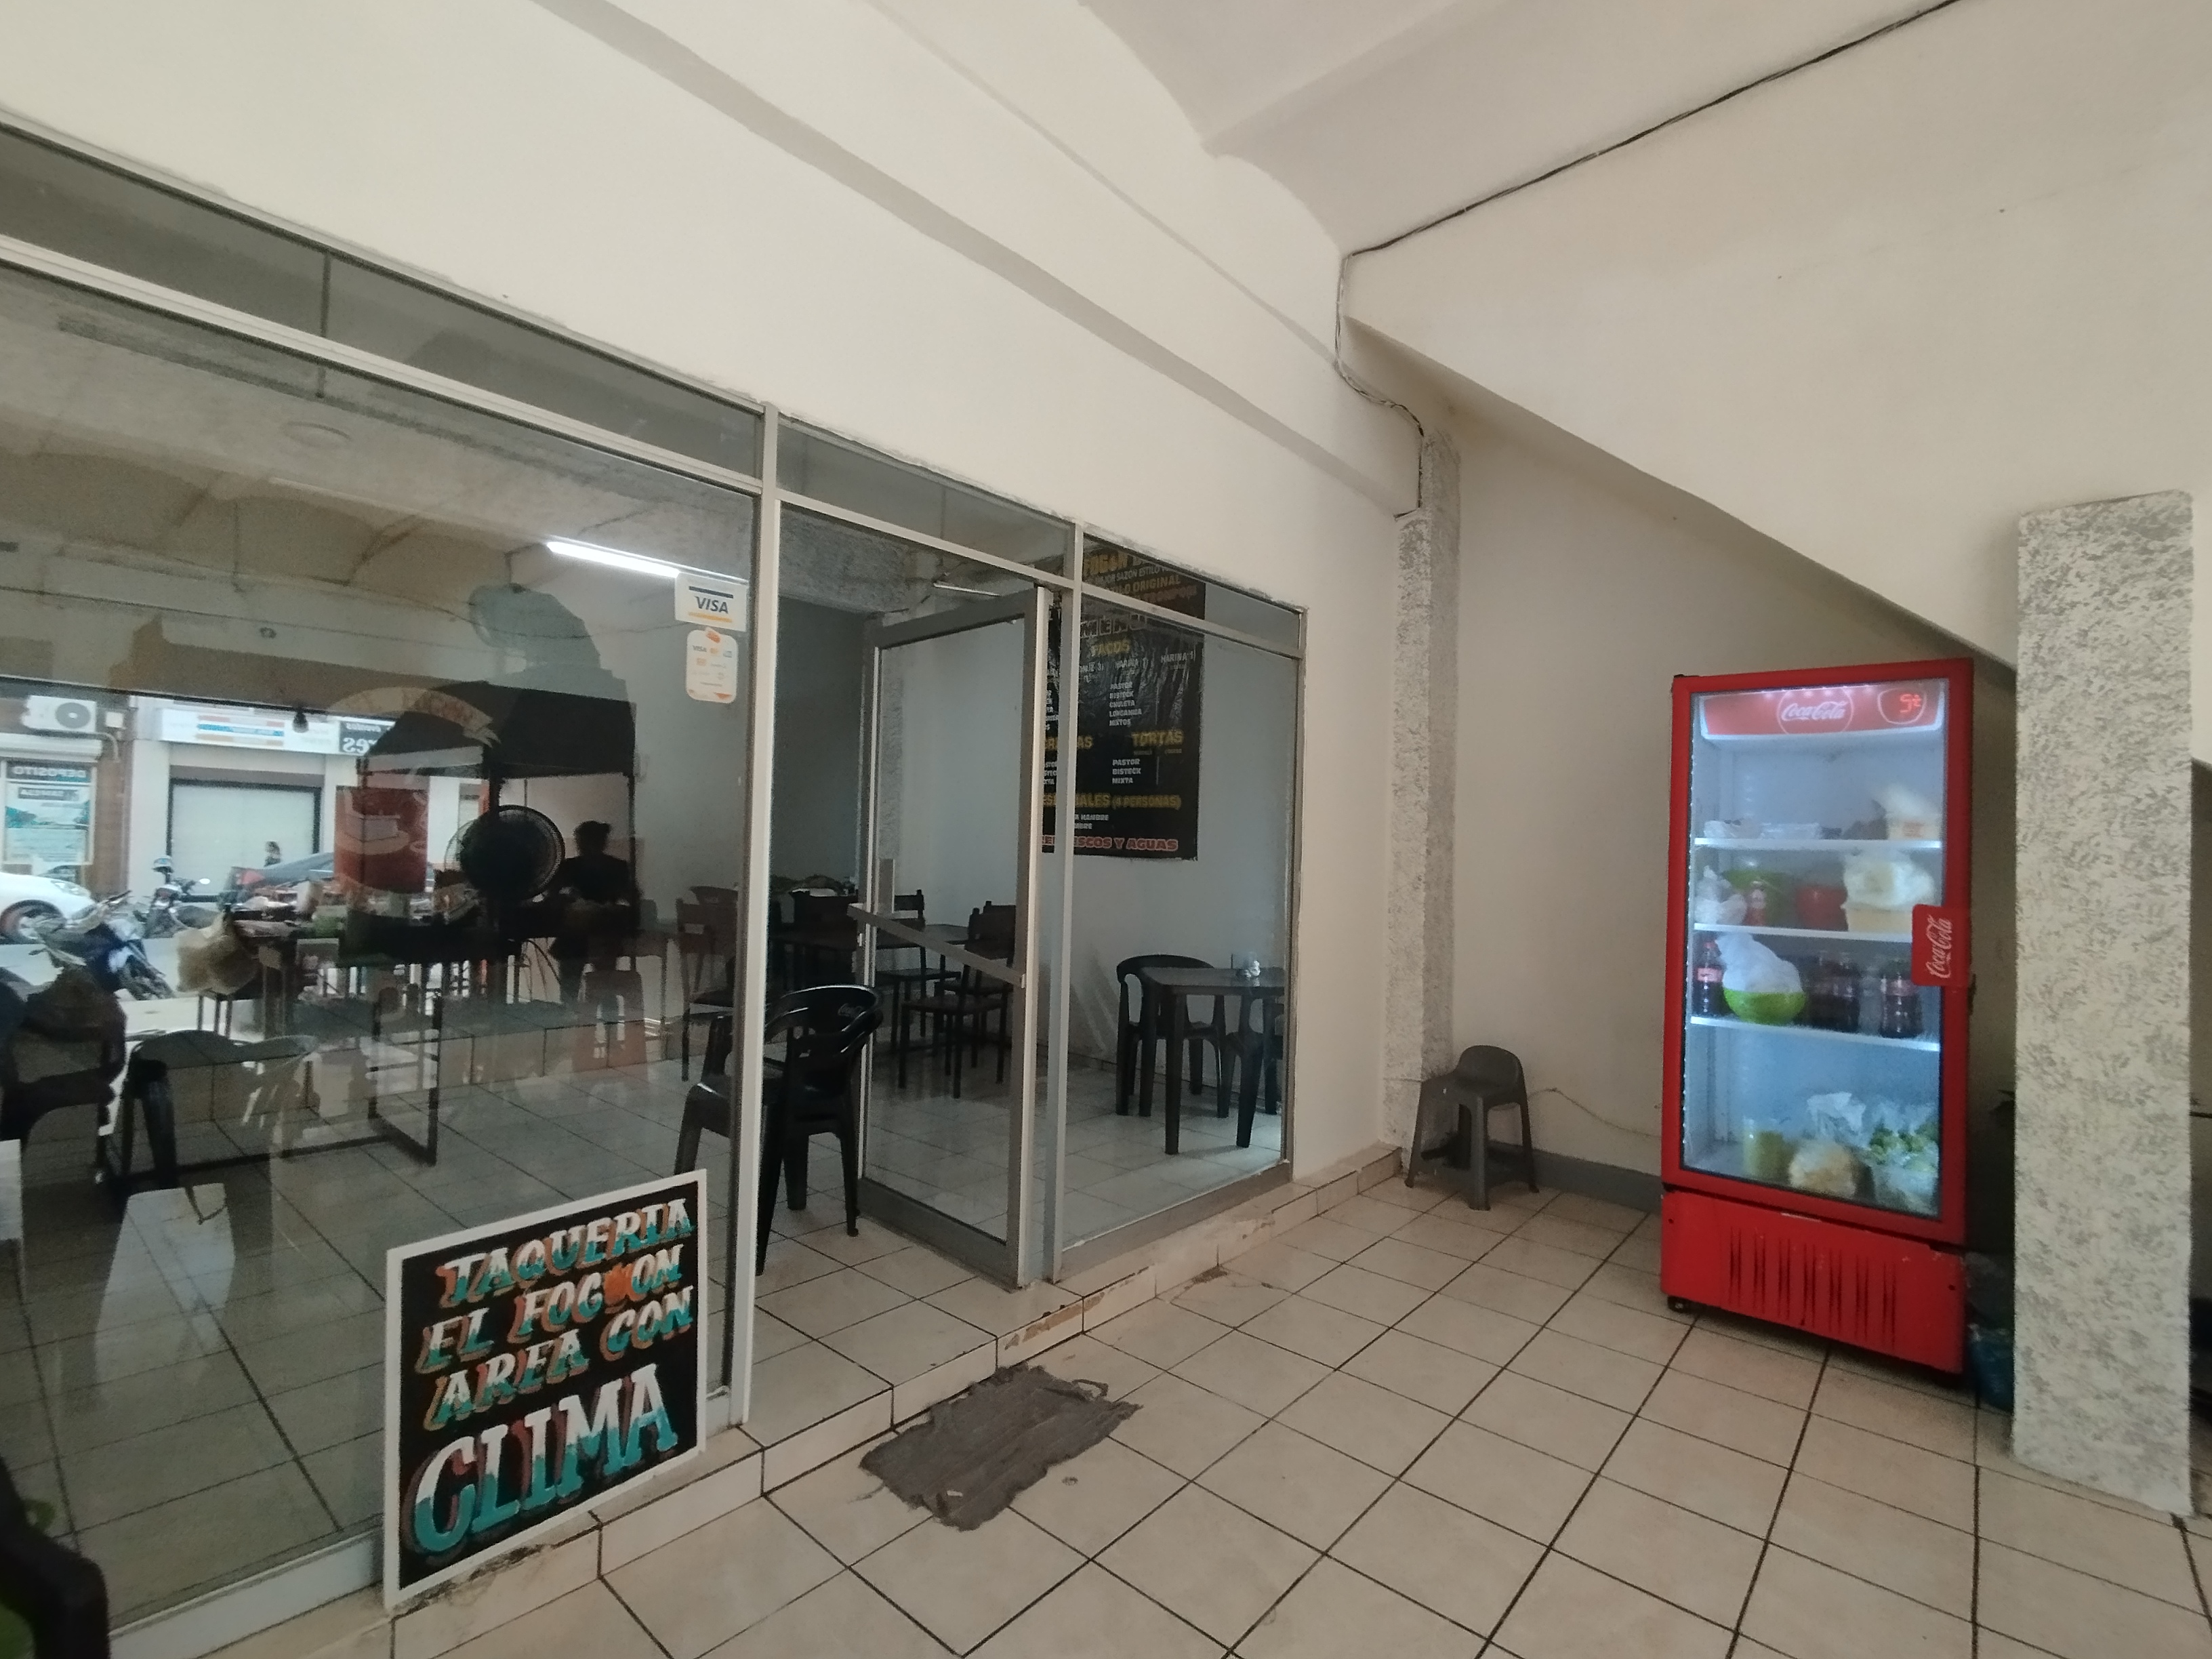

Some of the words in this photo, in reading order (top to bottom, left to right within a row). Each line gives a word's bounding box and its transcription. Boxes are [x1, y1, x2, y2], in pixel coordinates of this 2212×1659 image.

[1132, 575, 1181, 592] ORIGINAL
[695, 596, 729, 614] VISA
[692, 644, 708, 653] VISA
[1091, 638, 1130, 657] TACOS
[1781, 700, 1848, 721] Coca-Cola
[1131, 730, 1184, 746] TORTAS
[1112, 758, 1141, 766] PASTOR
[1112, 767, 1141, 775] BISTECK
[1113, 837, 1125, 849] Y
[1126, 838, 1179, 852] AGUAS
[1926, 914, 1952, 978] Coca-Cola
[439, 1199, 695, 1305] TAQUERIA
[419, 1307, 493, 1370] EL
[430, 1329, 589, 1427] AREA
[603, 1286, 693, 1357] CON
[411, 1363, 678, 1553] CLIMA
